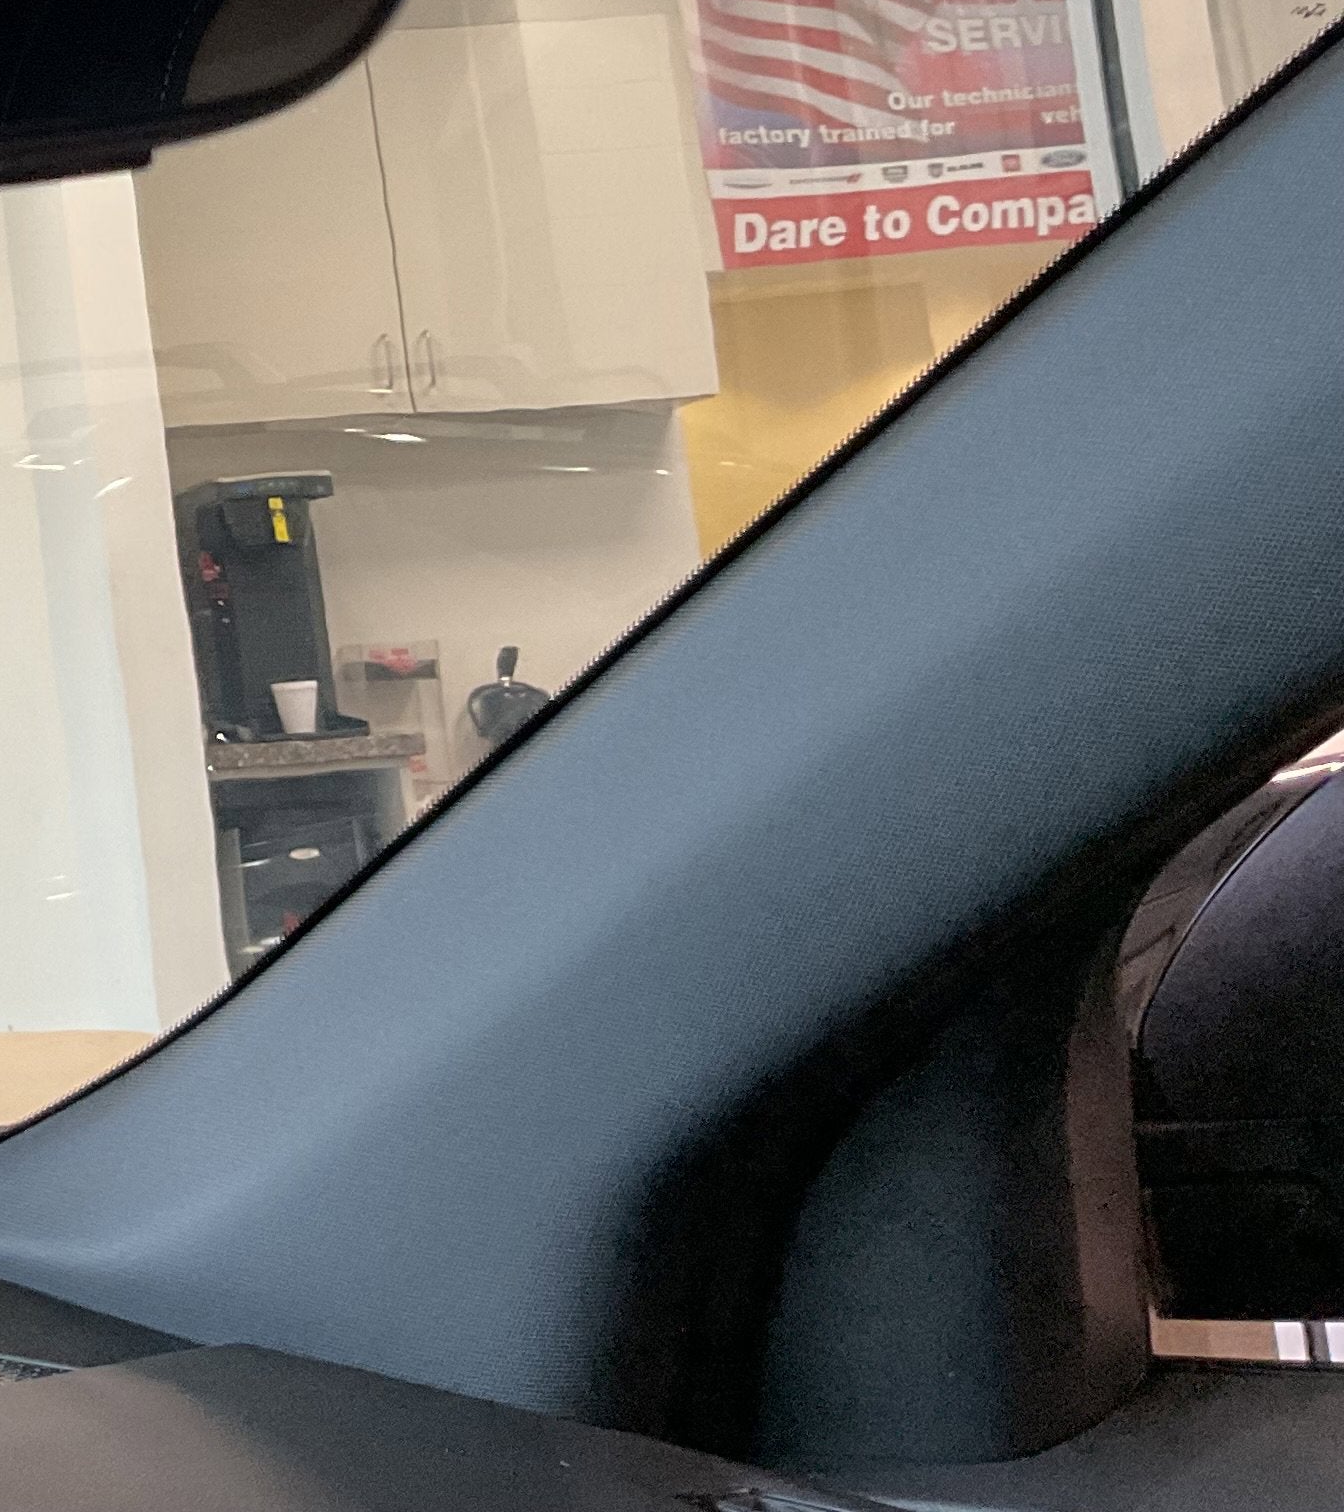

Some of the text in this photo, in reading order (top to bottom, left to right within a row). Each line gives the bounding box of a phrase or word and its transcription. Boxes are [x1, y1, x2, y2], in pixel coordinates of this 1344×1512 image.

[925, 15, 1063, 54] SERVI
[888, 91, 934, 111] Our
[718, 125, 811, 148] factory
[819, 119, 912, 143] trained
[918, 120, 956, 142] for
[734, 194, 1096, 254] Dare to Compa
